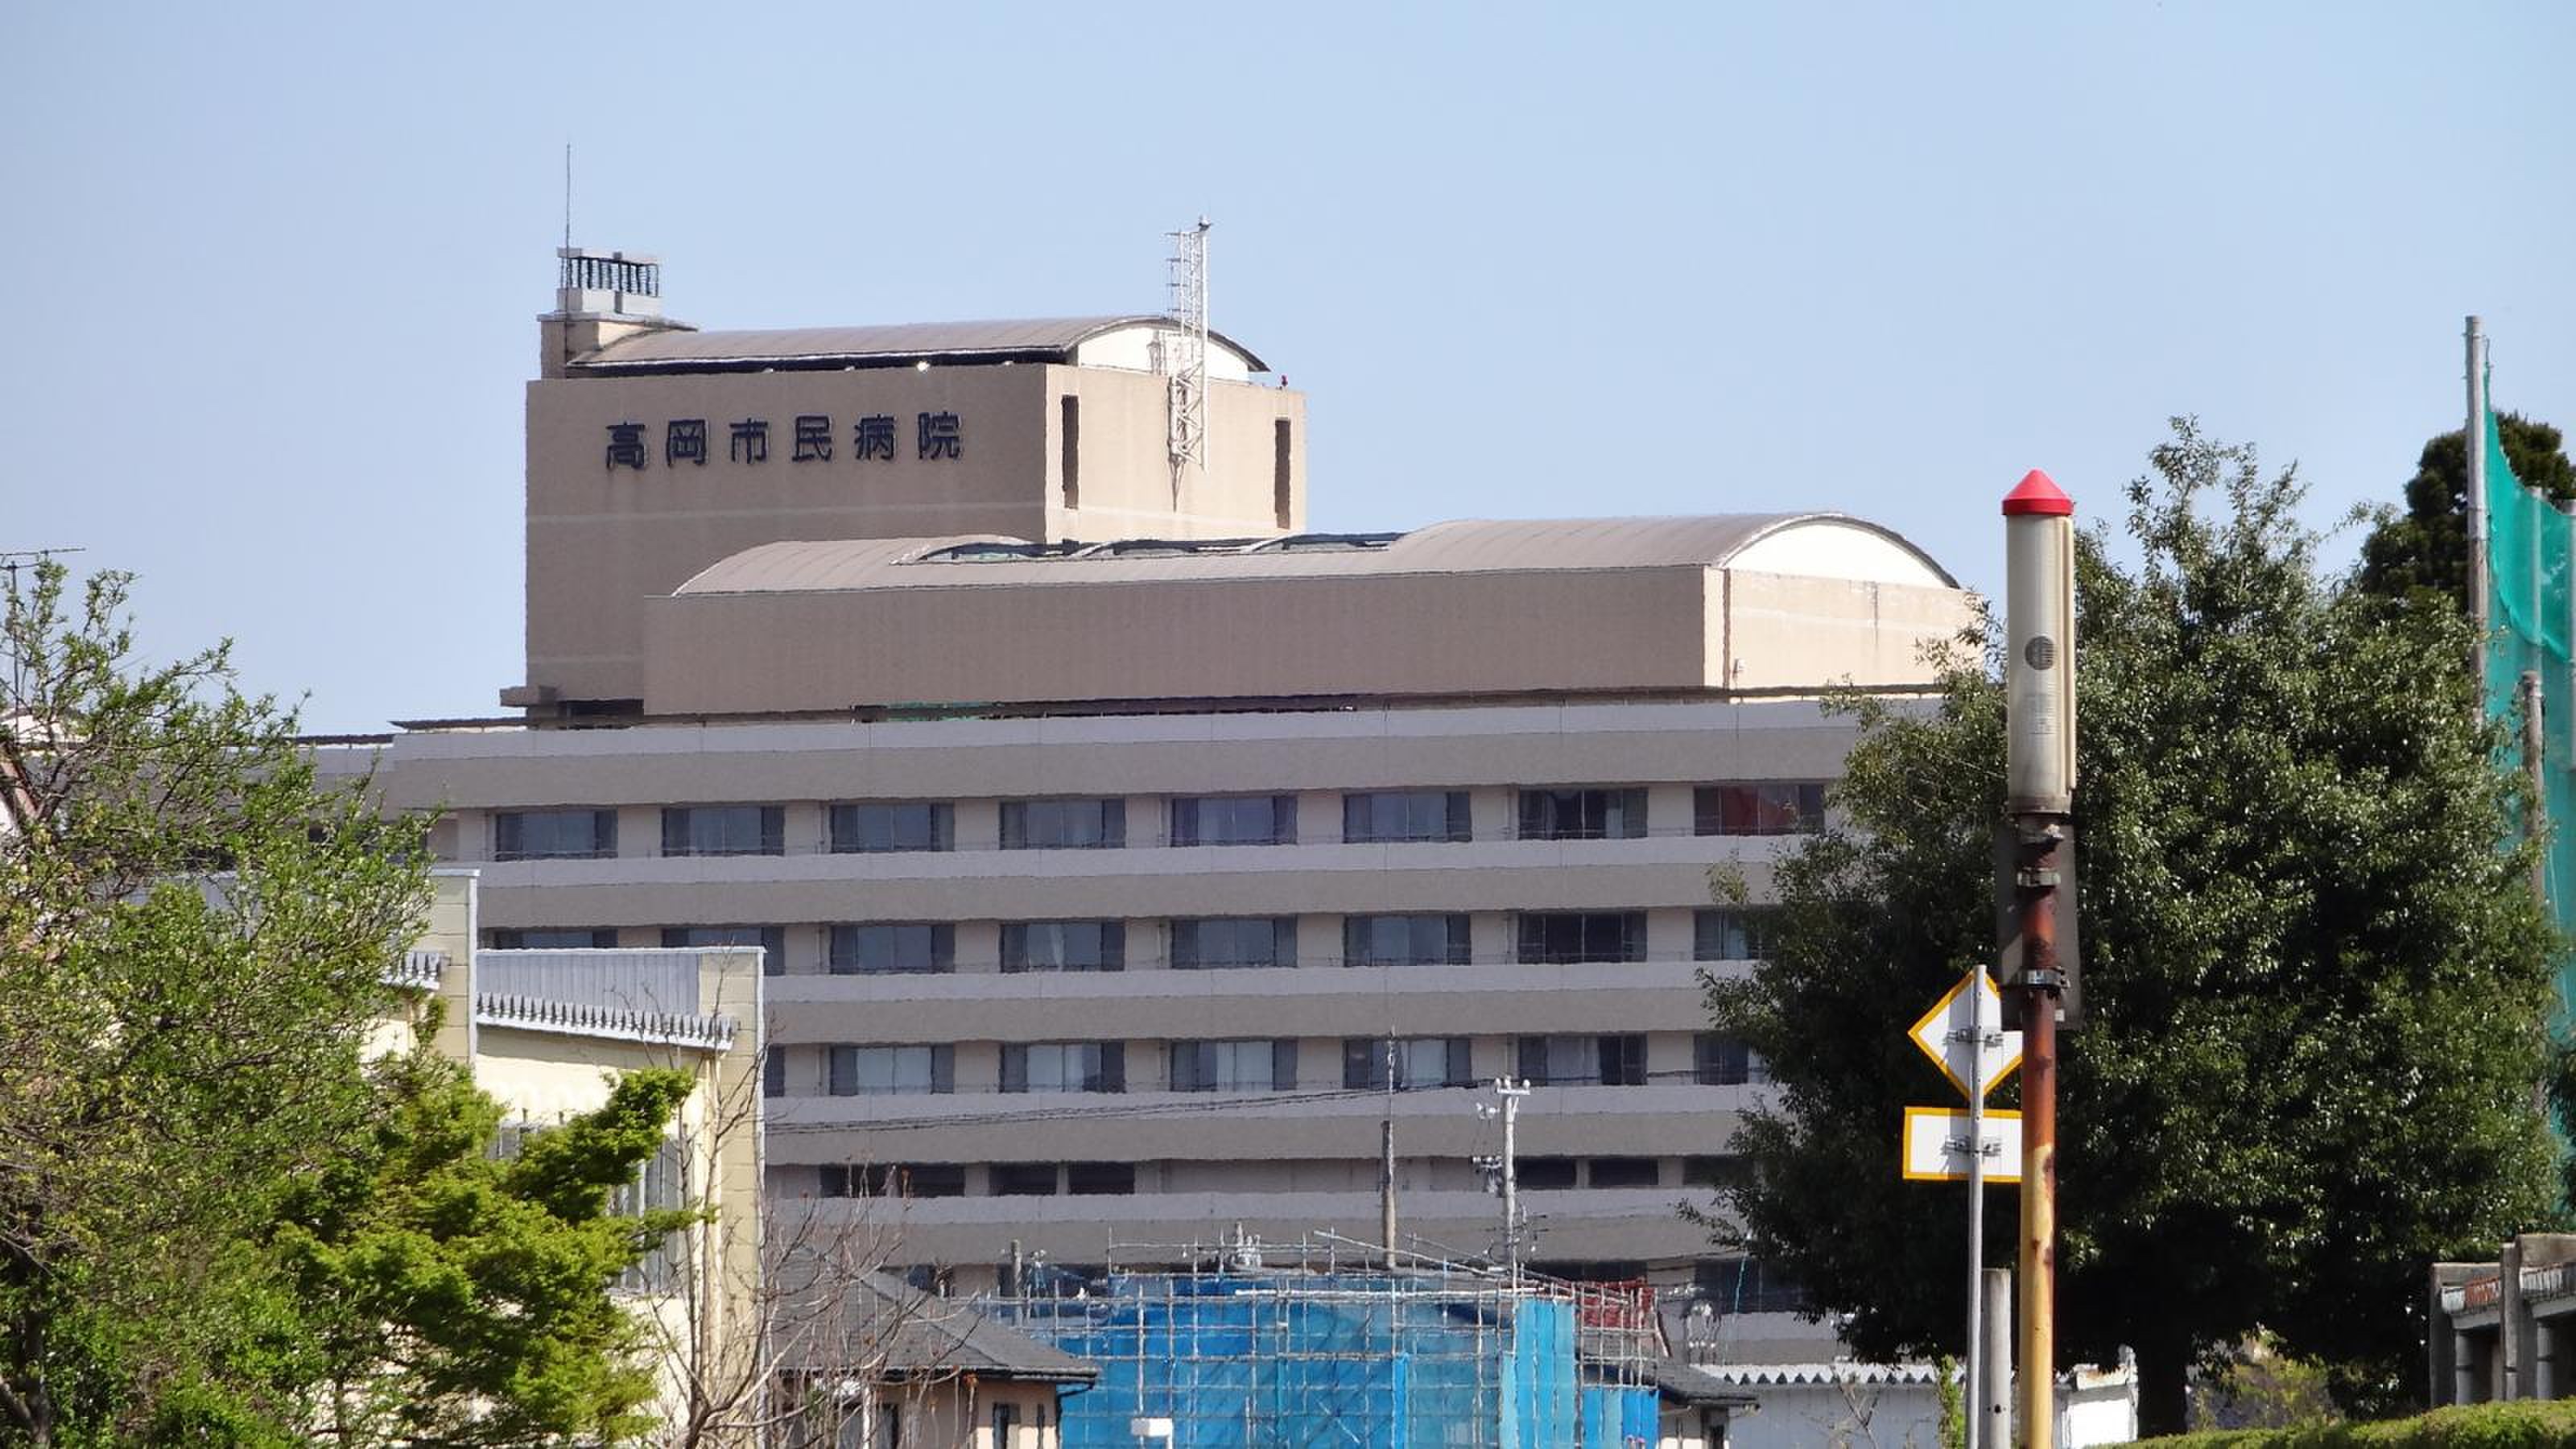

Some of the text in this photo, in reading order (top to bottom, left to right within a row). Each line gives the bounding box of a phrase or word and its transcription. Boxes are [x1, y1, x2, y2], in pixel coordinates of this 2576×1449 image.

[605, 411, 961, 469] 高岡市民病院
